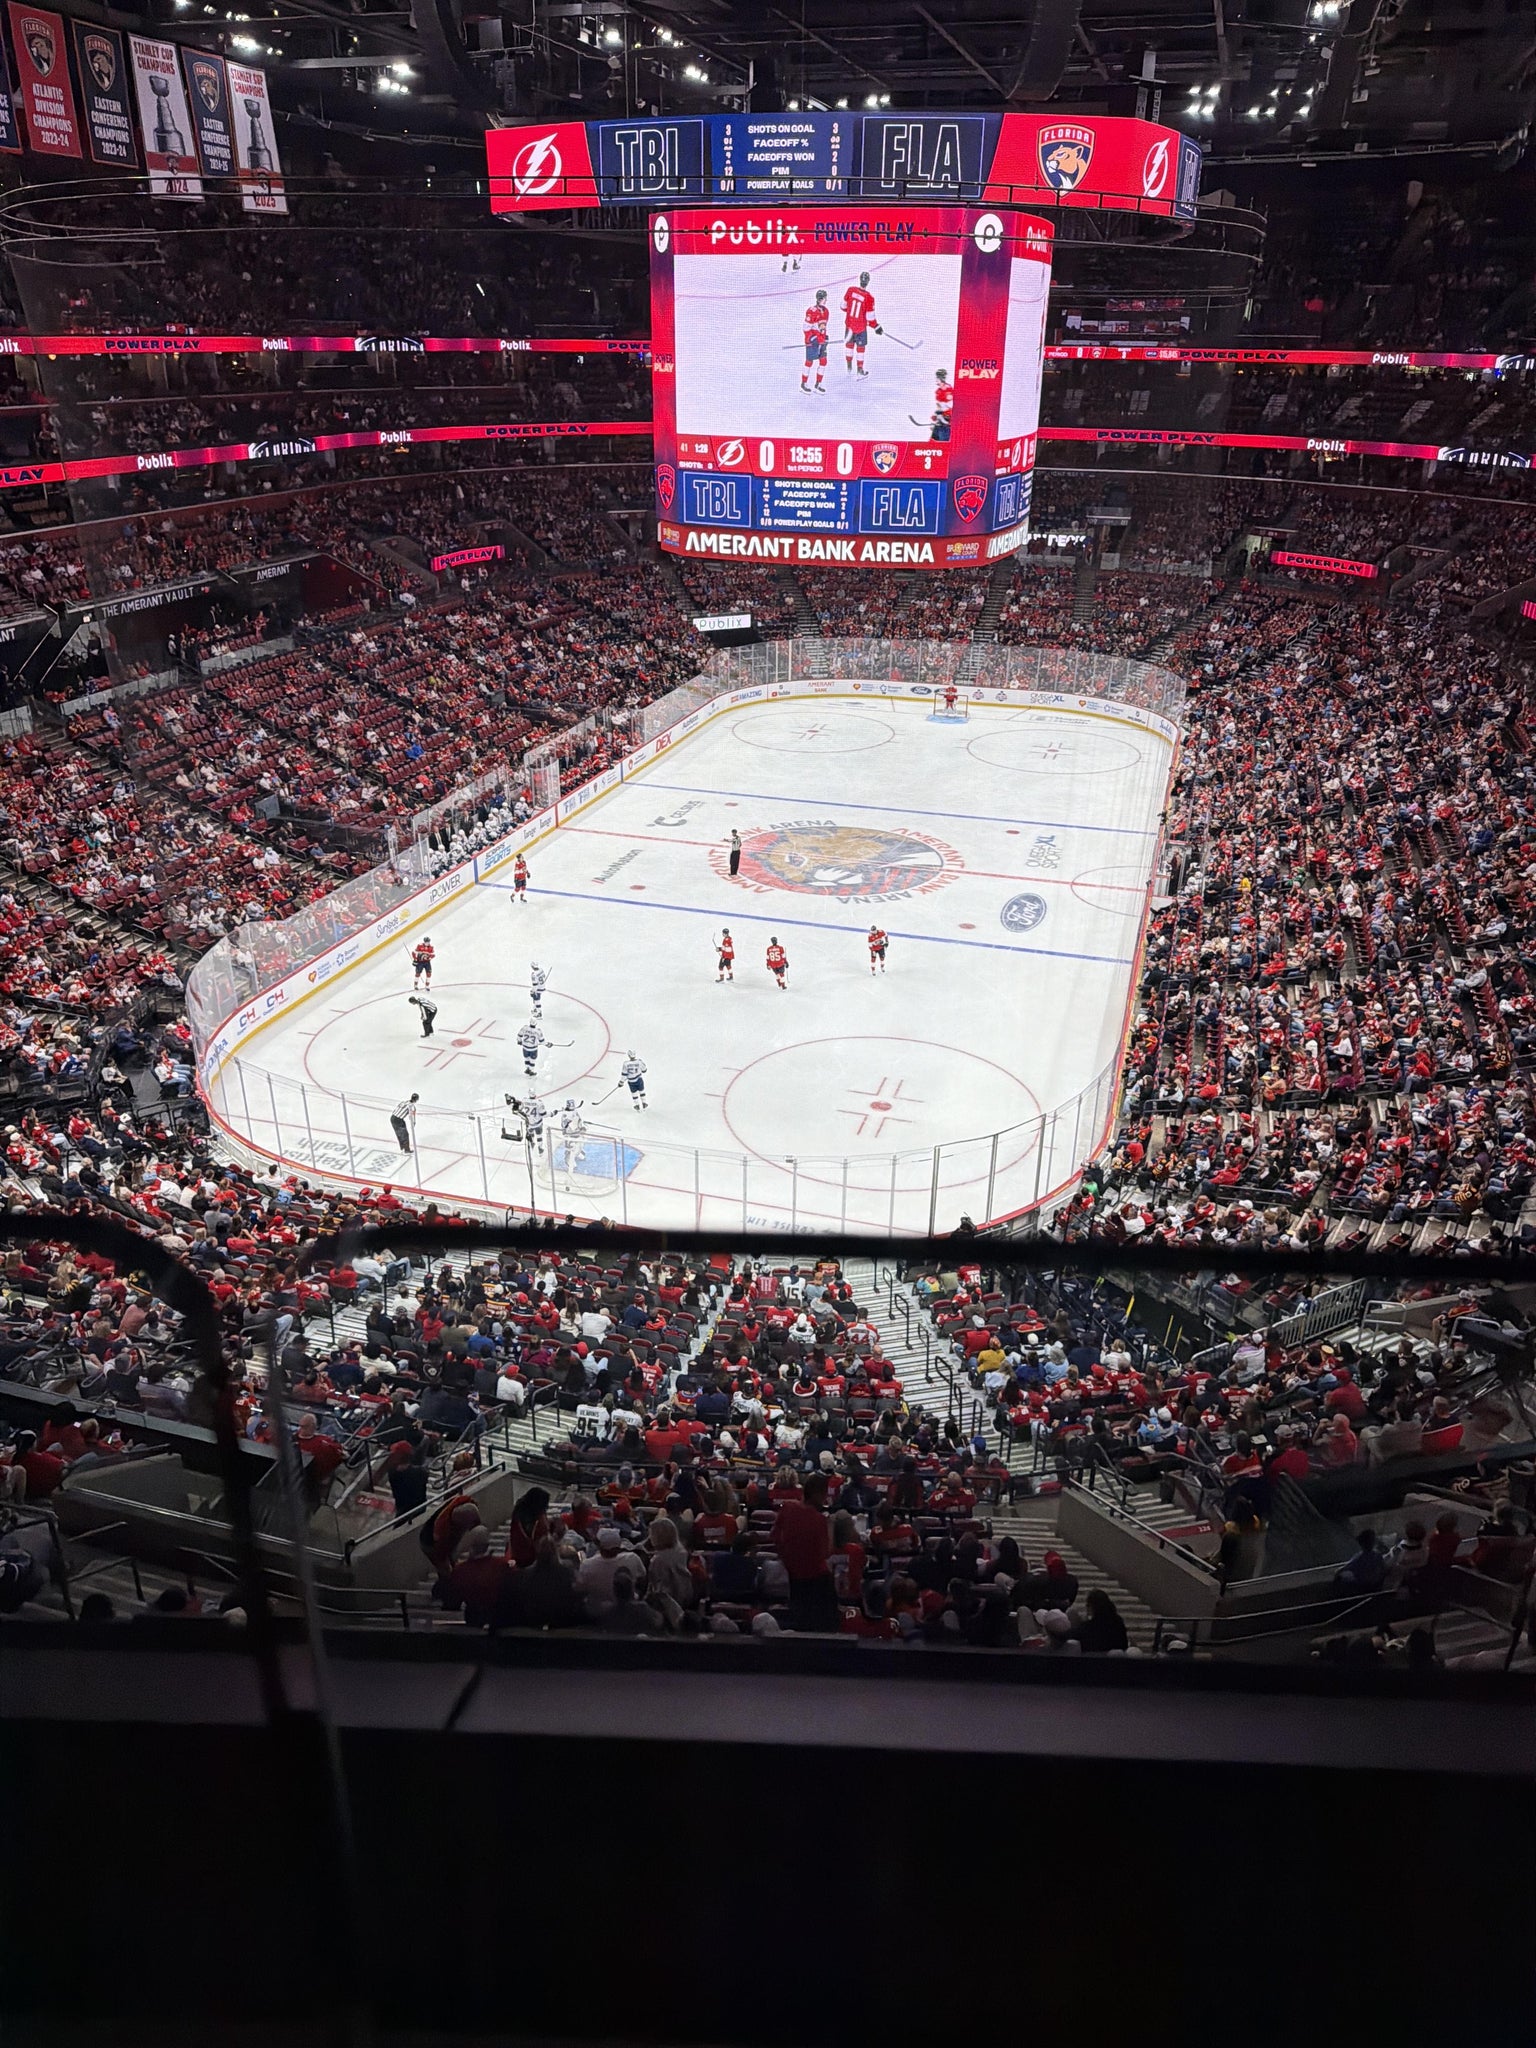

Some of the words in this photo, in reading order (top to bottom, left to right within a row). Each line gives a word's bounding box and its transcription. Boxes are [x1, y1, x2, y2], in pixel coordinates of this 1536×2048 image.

[134, 42, 159, 58] STANLEY
[162, 49, 173, 61] CUP
[137, 56, 175, 74] CHAMPIONS
[230, 68, 253, 82] STANLEY
[254, 74, 263, 85] CUP
[32, 83, 64, 100] ATLANTIC
[234, 82, 264, 98] CHAMPIONS
[35, 98, 66, 116] DIVISION
[94, 96, 122, 113] EASTERN
[33, 114, 72, 132] CHAMPIONS
[92, 110, 129, 129] CONFERENCE
[203, 117, 224, 131] EASTERN
[94, 126, 130, 143] CHAMPIONS
[726, 124, 732, 136] 3
[748, 125, 776, 134] SHOTS
[778, 125, 790, 133] ON
[791, 124, 815, 132] GOAL
[832, 123, 838, 134] 3
[1044, 128, 1090, 142] FLORIDA
[41, 131, 70, 147] 2023-24
[201, 130, 230, 146] CONFERENCE
[754, 139, 798, 148] FACEOFF
[801, 139, 809, 147] %
[102, 142, 126, 157] 2023-24
[204, 144, 230, 159] CHAMPIONS
[881, 124, 961, 188] FLA
[616, 128, 686, 191] TBL
[748, 153, 792, 162] FACEOFFS
[794, 153, 814, 161] WON
[832, 152, 838, 162] 2
[724, 166, 733, 176] 12
[772, 167, 790, 175] PIM
[832, 166, 838, 176] 0
[165, 179, 188, 193] 2024
[748, 180, 771, 189] POWER
[772, 180, 789, 188] PLAY
[826, 179, 842, 191] 0/1
[256, 195, 276, 208] 2025
[711, 220, 799, 244] Publix
[815, 222, 870, 242] POWER
[876, 222, 914, 242] PLAY
[850, 300, 862, 318] 11
[106, 340, 160, 349] POWER
[164, 340, 200, 349] PLAY
[262, 338, 288, 350] Publix
[500, 340, 531, 350] Publix
[1180, 351, 1238, 359] POWER
[1244, 352, 1290, 360] PLAY
[1372, 353, 1410, 364] Publix
[654, 363, 674, 372] PLAY
[962, 359, 998, 369] POWER
[958, 369, 1000, 379] PLAY
[380, 430, 411, 443] Publix
[486, 427, 542, 436] POWER
[1097, 431, 1162, 440] POWER
[1168, 434, 1215, 442] PLAY
[680, 443, 688, 452] 41
[1307, 439, 1346, 452] Publix
[760, 440, 774, 472] 0
[790, 446, 822, 463] 13:55
[837, 443, 852, 475] 0
[138, 454, 174, 469] Publix
[924, 457, 932, 470] 3
[0, 468, 44, 484] LAY
[774, 480, 800, 488] SHOTS
[814, 482, 836, 490] GOAL
[693, 480, 740, 520] TBL
[783, 490, 818, 498] FACEOFF
[774, 500, 815, 508] FACEOFFS
[816, 501, 835, 509] WON
[841, 502, 846, 510] 2
[872, 488, 925, 526] FLA
[763, 508, 770, 516] 12
[796, 510, 812, 518] PIM
[774, 518, 795, 526] POWER
[796, 520, 813, 528] PLAY
[813, 520, 834, 528] GOALS
[686, 532, 794, 558] AMERANT
[798, 539, 856, 561] BANK
[860, 541, 934, 562] ARENA
[468, 551, 491, 560] PLAY
[1287, 556, 1330, 567] POWER
[1334, 562, 1363, 572] PLAY
[256, 564, 290, 580] AMERANT
[102, 604, 119, 618] THE
[120, 594, 164, 614] AMERANT
[166, 586, 194, 603] VAULT
[700, 618, 742, 630] Publix
[1052, 694, 1064, 702] XL
[769, 820, 836, 830] ARENA
[892, 827, 965, 868] AMERANT
[484, 845, 512, 870] SPORTS
[913, 874, 960, 894] BANK
[836, 891, 912, 904] ARENA
[524, 1034, 536, 1044] 23
[298, 1138, 364, 1157] Health
[850, 1334, 870, 1344] 44
[578, 1417, 599, 1436] 95
